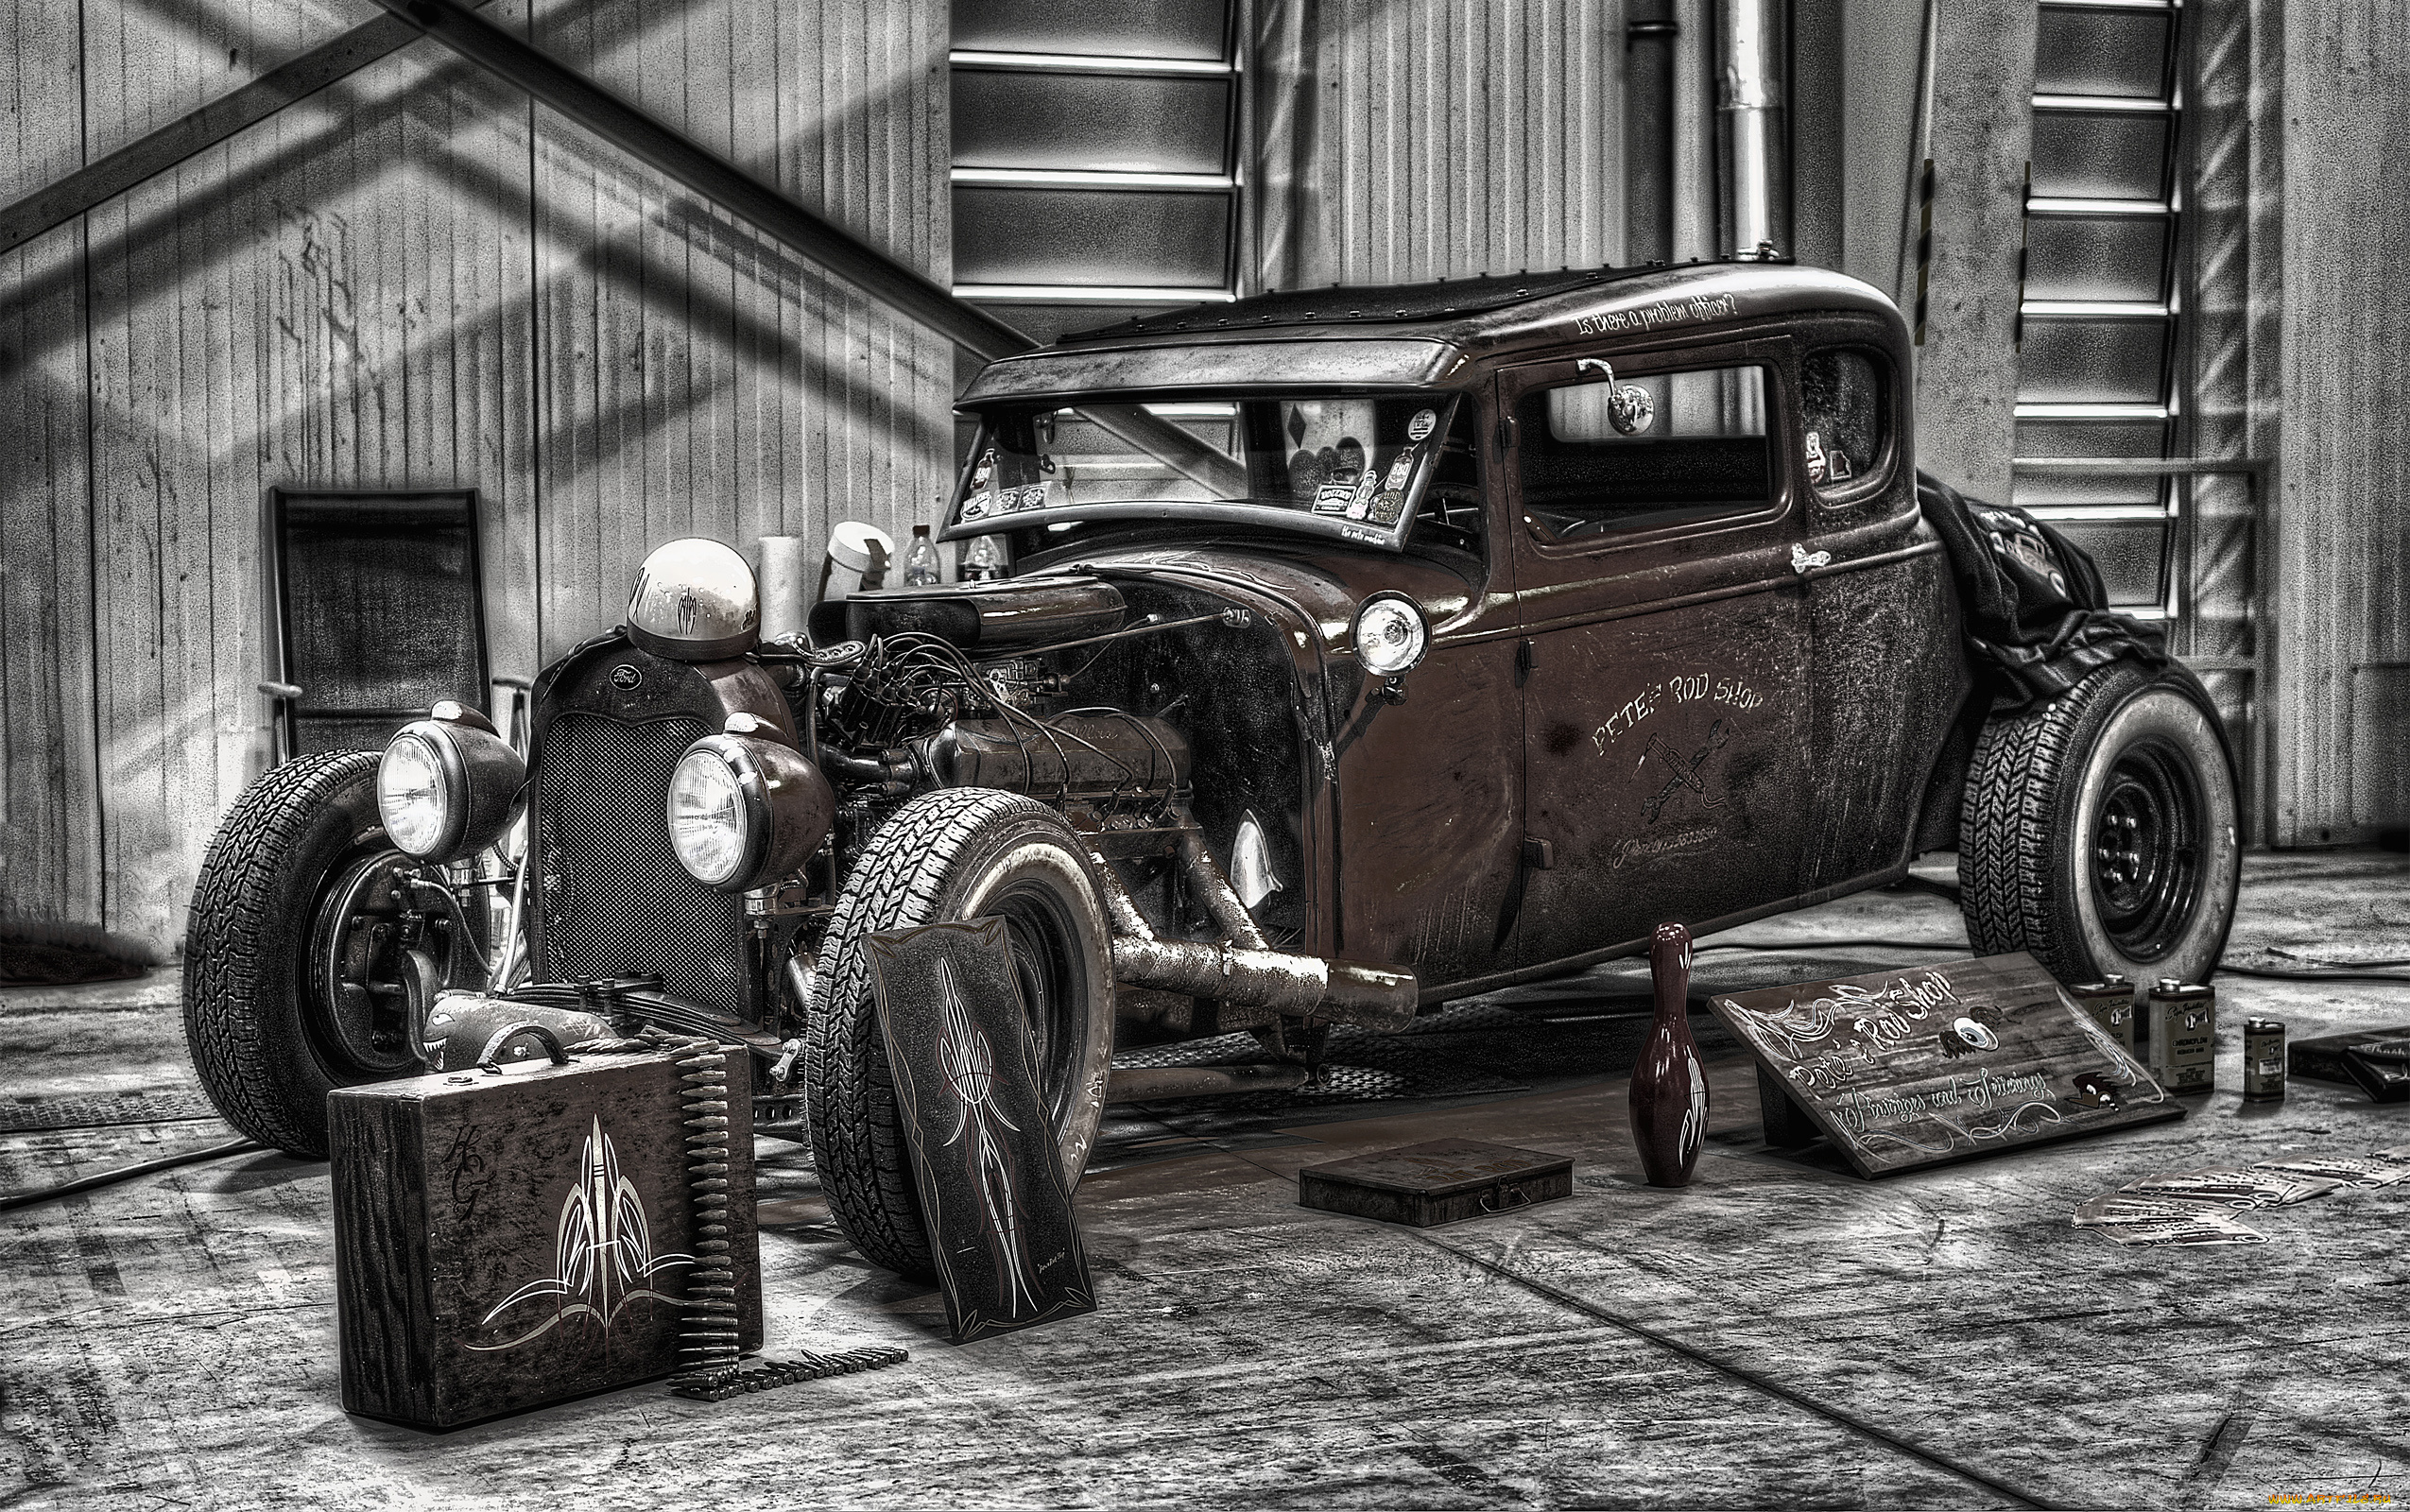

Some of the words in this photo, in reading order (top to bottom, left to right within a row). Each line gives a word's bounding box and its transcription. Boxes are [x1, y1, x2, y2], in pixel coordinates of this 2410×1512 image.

[1573, 317, 1593, 335] Is
[1592, 312, 1630, 333] there
[1629, 311, 1643, 326] a
[1640, 300, 1690, 331] problem
[1689, 293, 1738, 321] officer?
[613, 668, 637, 683] Ford
[1669, 672, 1710, 704] ROD
[1713, 677, 1764, 711] SHOP
[1889, 971, 1963, 1020] Shop
